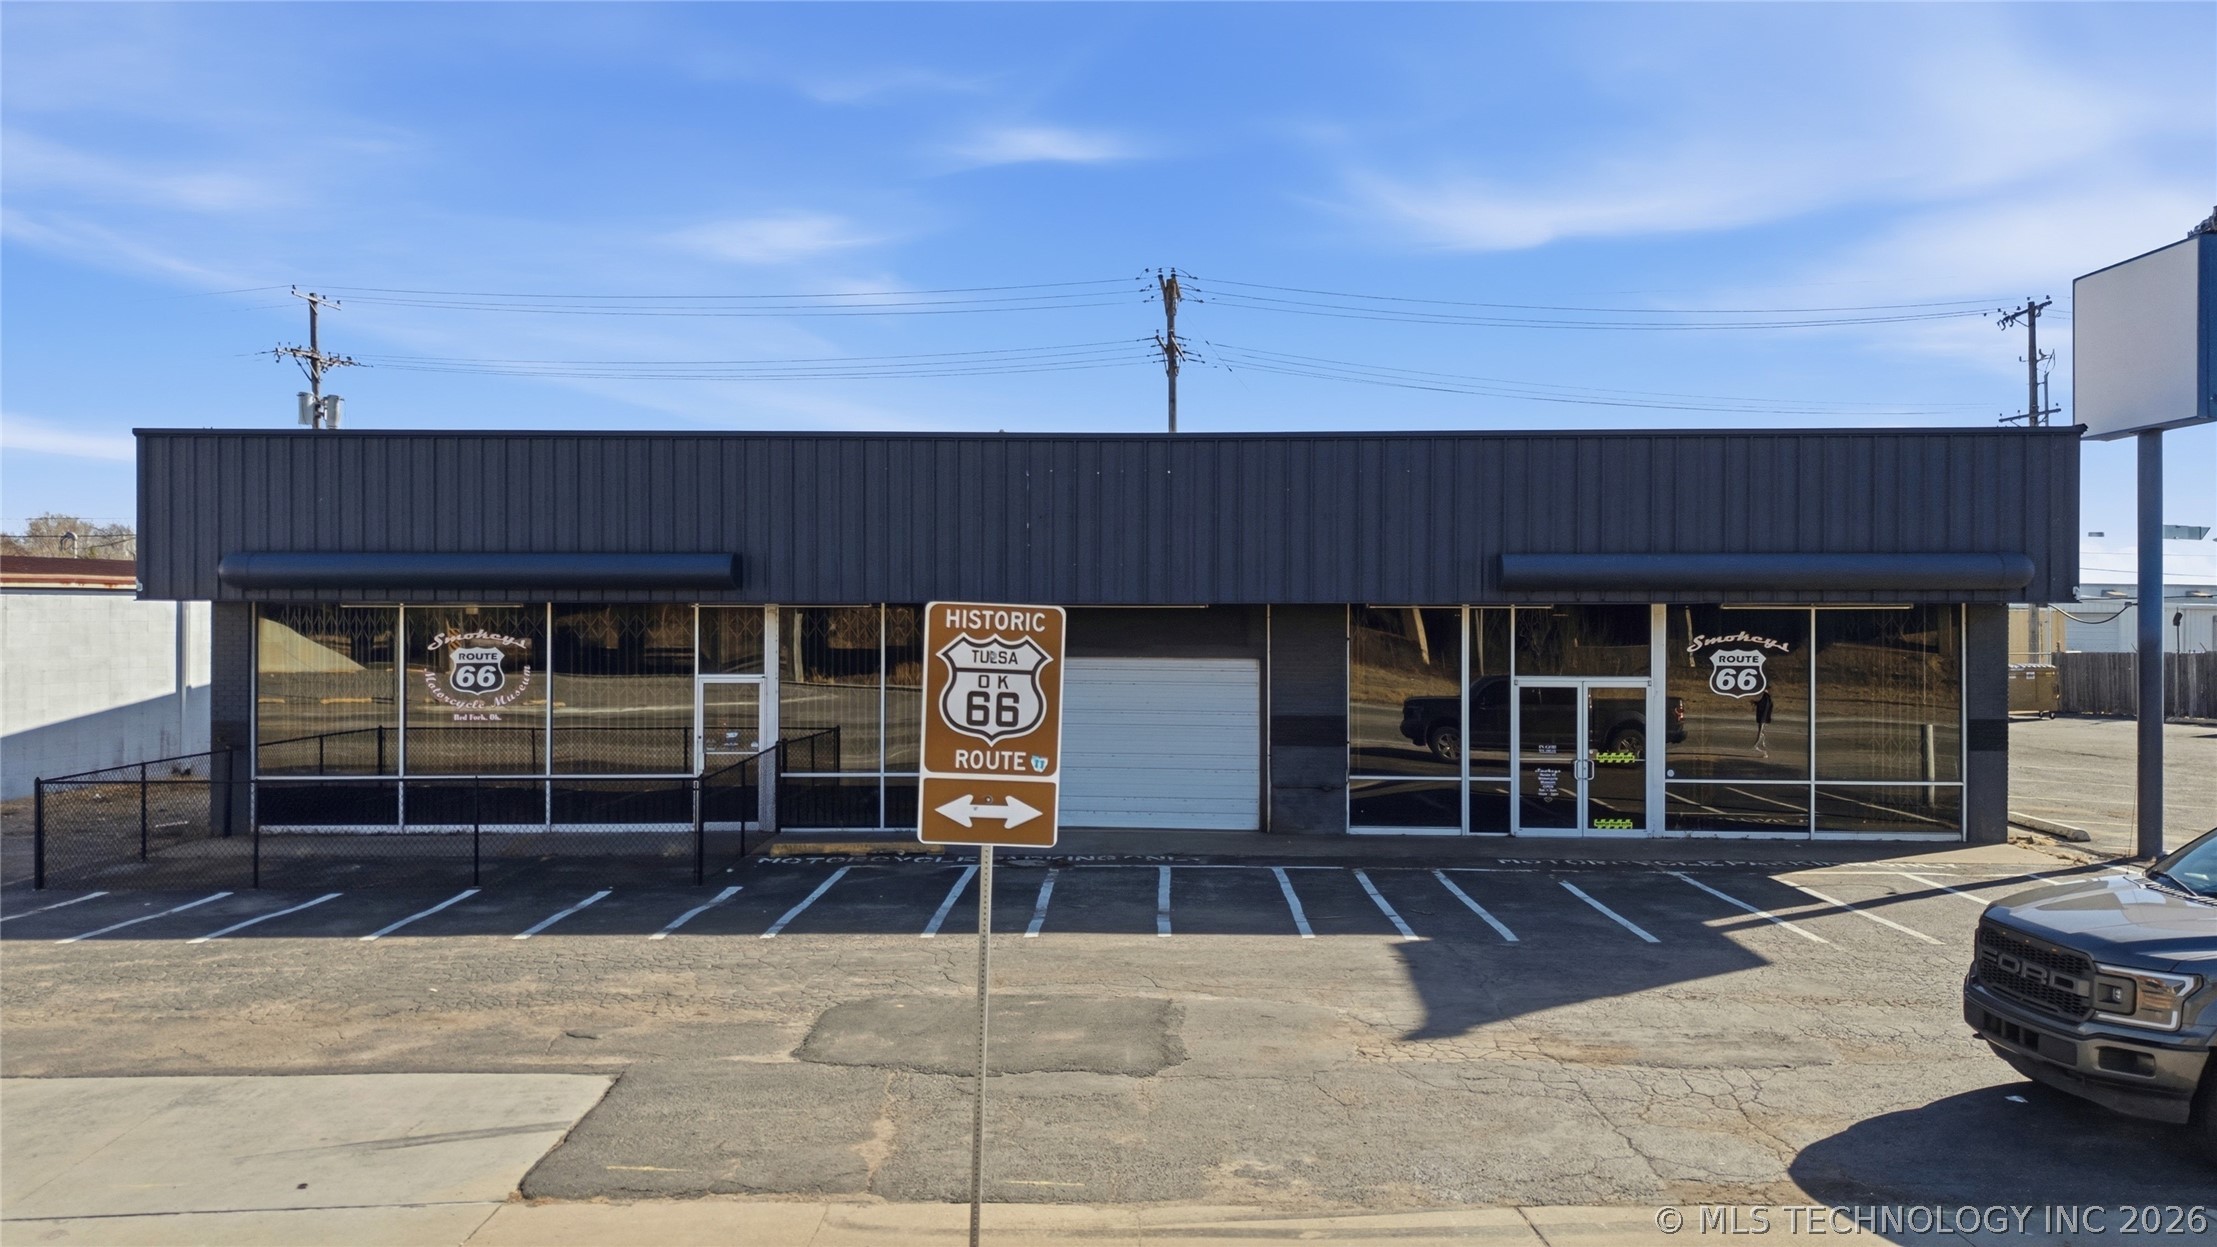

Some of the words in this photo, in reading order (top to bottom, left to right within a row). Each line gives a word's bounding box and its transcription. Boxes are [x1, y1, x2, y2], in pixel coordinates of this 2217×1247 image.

[946, 609, 1046, 632] HISTORIC
[427, 629, 526, 651] Smokeys
[1686, 631, 1790, 653] Smokeys
[458, 652, 498, 661] ROUTE
[972, 650, 1018, 665] TULSA
[1718, 655, 1760, 664] ROUTE
[423, 668, 485, 710] Motorcycle
[491, 664, 531, 708] Museum
[456, 665, 497, 688] 66
[1716, 668, 1758, 691] 66
[966, 691, 1020, 728] 66
[955, 749, 1027, 771] ROUTE
[1980, 946, 2089, 997] FORD
